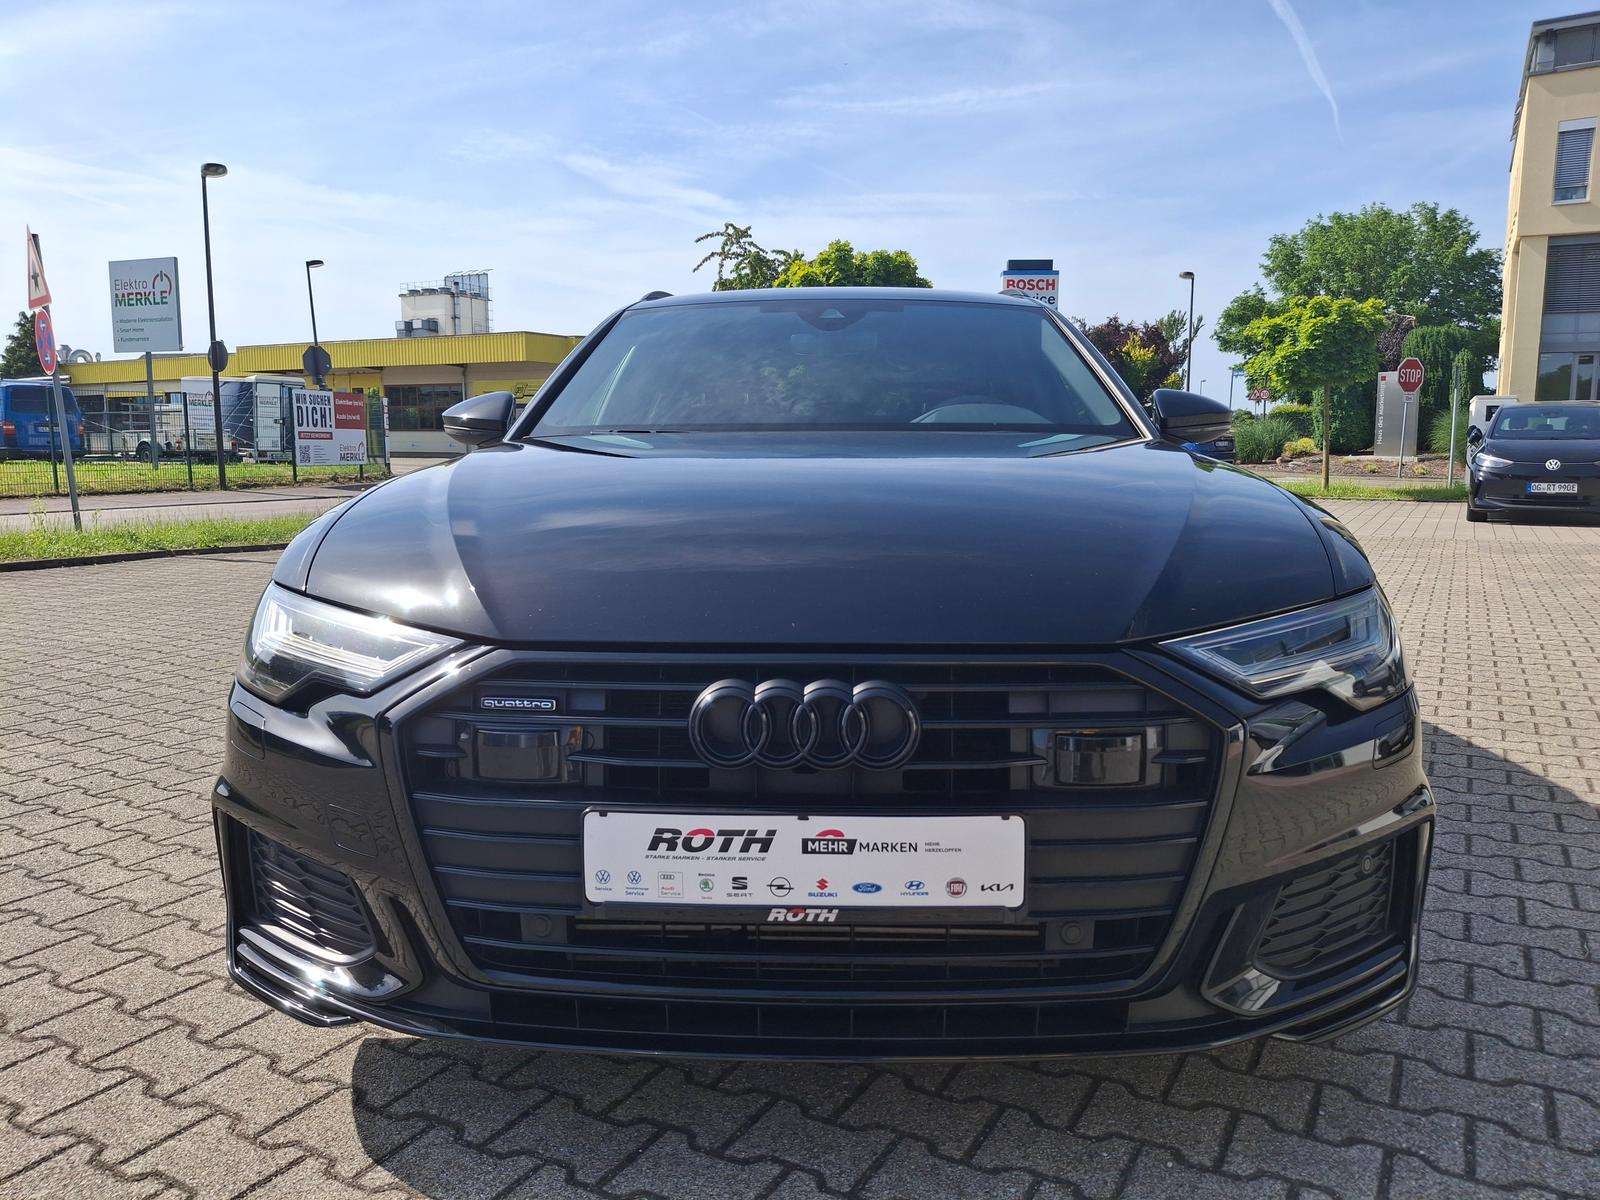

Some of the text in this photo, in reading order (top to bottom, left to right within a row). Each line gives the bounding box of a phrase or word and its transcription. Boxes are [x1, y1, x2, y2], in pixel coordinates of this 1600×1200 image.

[114, 279, 148, 291] Elektro
[1006, 279, 1056, 291] BOSCH
[115, 291, 168, 307] MERKLE
[1400, 369, 1422, 383] STOP
[295, 393, 331, 407] WIR SUCHEN
[296, 405, 332, 428] DICH!
[340, 453, 365, 461] MERKLE
[484, 700, 552, 708] quattro
[647, 828, 777, 853] ROTH
[807, 840, 918, 853] MEHR MARKEN
[767, 908, 839, 922] ROTH
